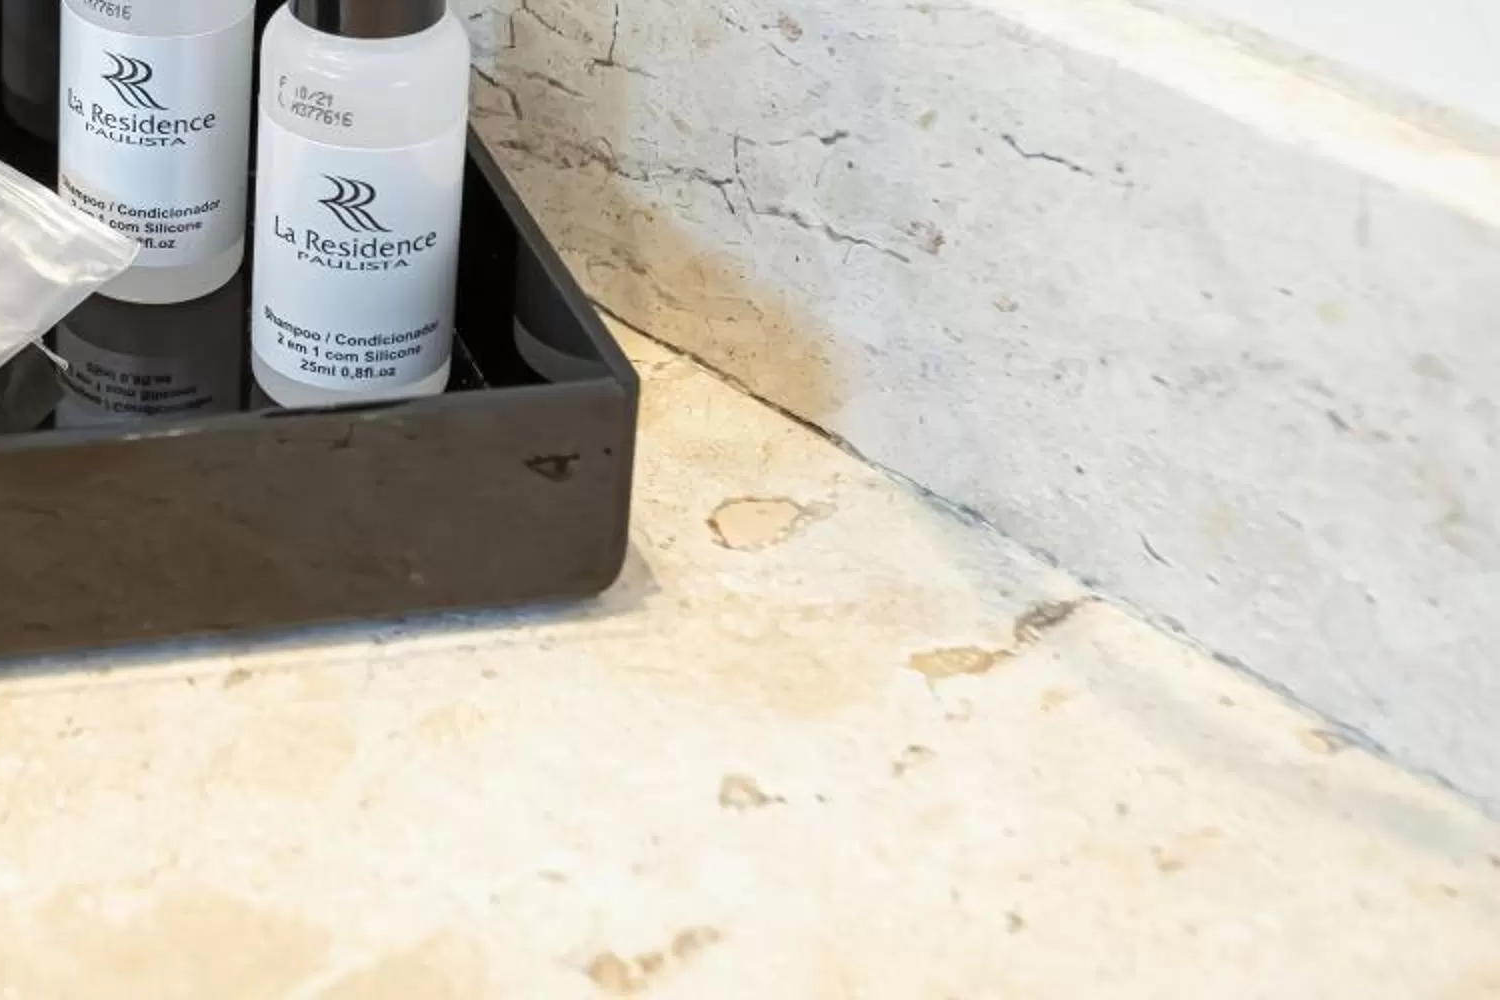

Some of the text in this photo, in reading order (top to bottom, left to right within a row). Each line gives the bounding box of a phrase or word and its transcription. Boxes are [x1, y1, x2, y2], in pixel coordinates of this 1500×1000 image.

[295, 85, 334, 108] 10/21
[67, 87, 217, 135] La Residence
[85, 122, 187, 148] PAULISTA
[117, 199, 221, 220] Condicionador
[109, 218, 141, 233] com
[144, 220, 204, 234] Silicone
[274, 214, 438, 260] La Residence
[297, 250, 411, 272] PAULISTA
[263, 303, 321, 342] Shampoo
[334, 319, 439, 348] Condicionador
[276, 331, 285, 345] 2
[287, 339, 308, 355] em
[325, 350, 359, 363] com
[364, 343, 422, 364] Silicone
[299, 357, 336, 378] 25ml
